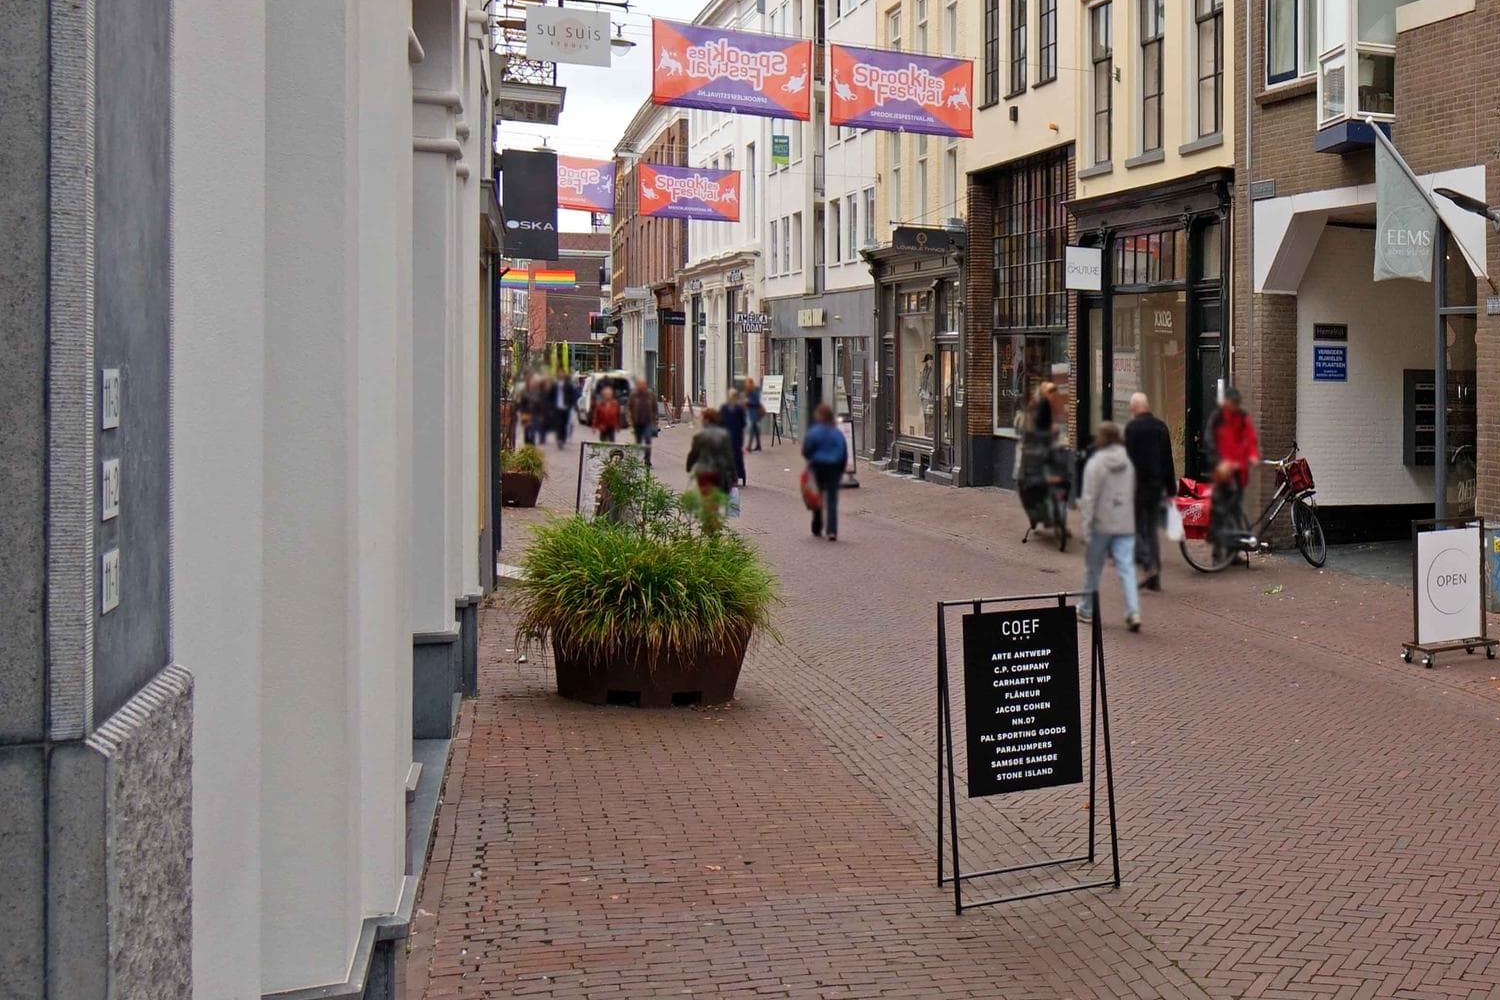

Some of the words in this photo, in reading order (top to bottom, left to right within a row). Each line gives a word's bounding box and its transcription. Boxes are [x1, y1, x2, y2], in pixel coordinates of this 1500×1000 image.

[566, 26, 601, 41] suis
[854, 63, 944, 92] Sprookjes
[876, 83, 943, 107] Festival
[655, 173, 720, 193] Sprookjes
[672, 187, 718, 202] Festival
[1387, 229, 1432, 246] EEMS
[1437, 573, 1467, 587] OPEN
[1002, 618, 1040, 636] COEF
[991, 652, 1012, 661] ARTE
[1013, 648, 1052, 659] ANTWERP
[993, 666, 1009, 674] C.P.
[1011, 662, 1050, 673] COMPANY
[993, 676, 1035, 687] CARHARTT
[1036, 675, 1052, 683] WIP
[995, 704, 1021, 714] JACOB
[1023, 701, 1051, 711] COHEN
[1011, 716, 1036, 726] NN.07
[980, 734, 995, 743] PAL
[997, 729, 1037, 741] SPORTING
[1038, 726, 1067, 736] GOODS
[996, 741, 1053, 754] PARAJUMPERS
[996, 771, 1023, 781] STONE
[1024, 767, 1054, 778] ISLAND
